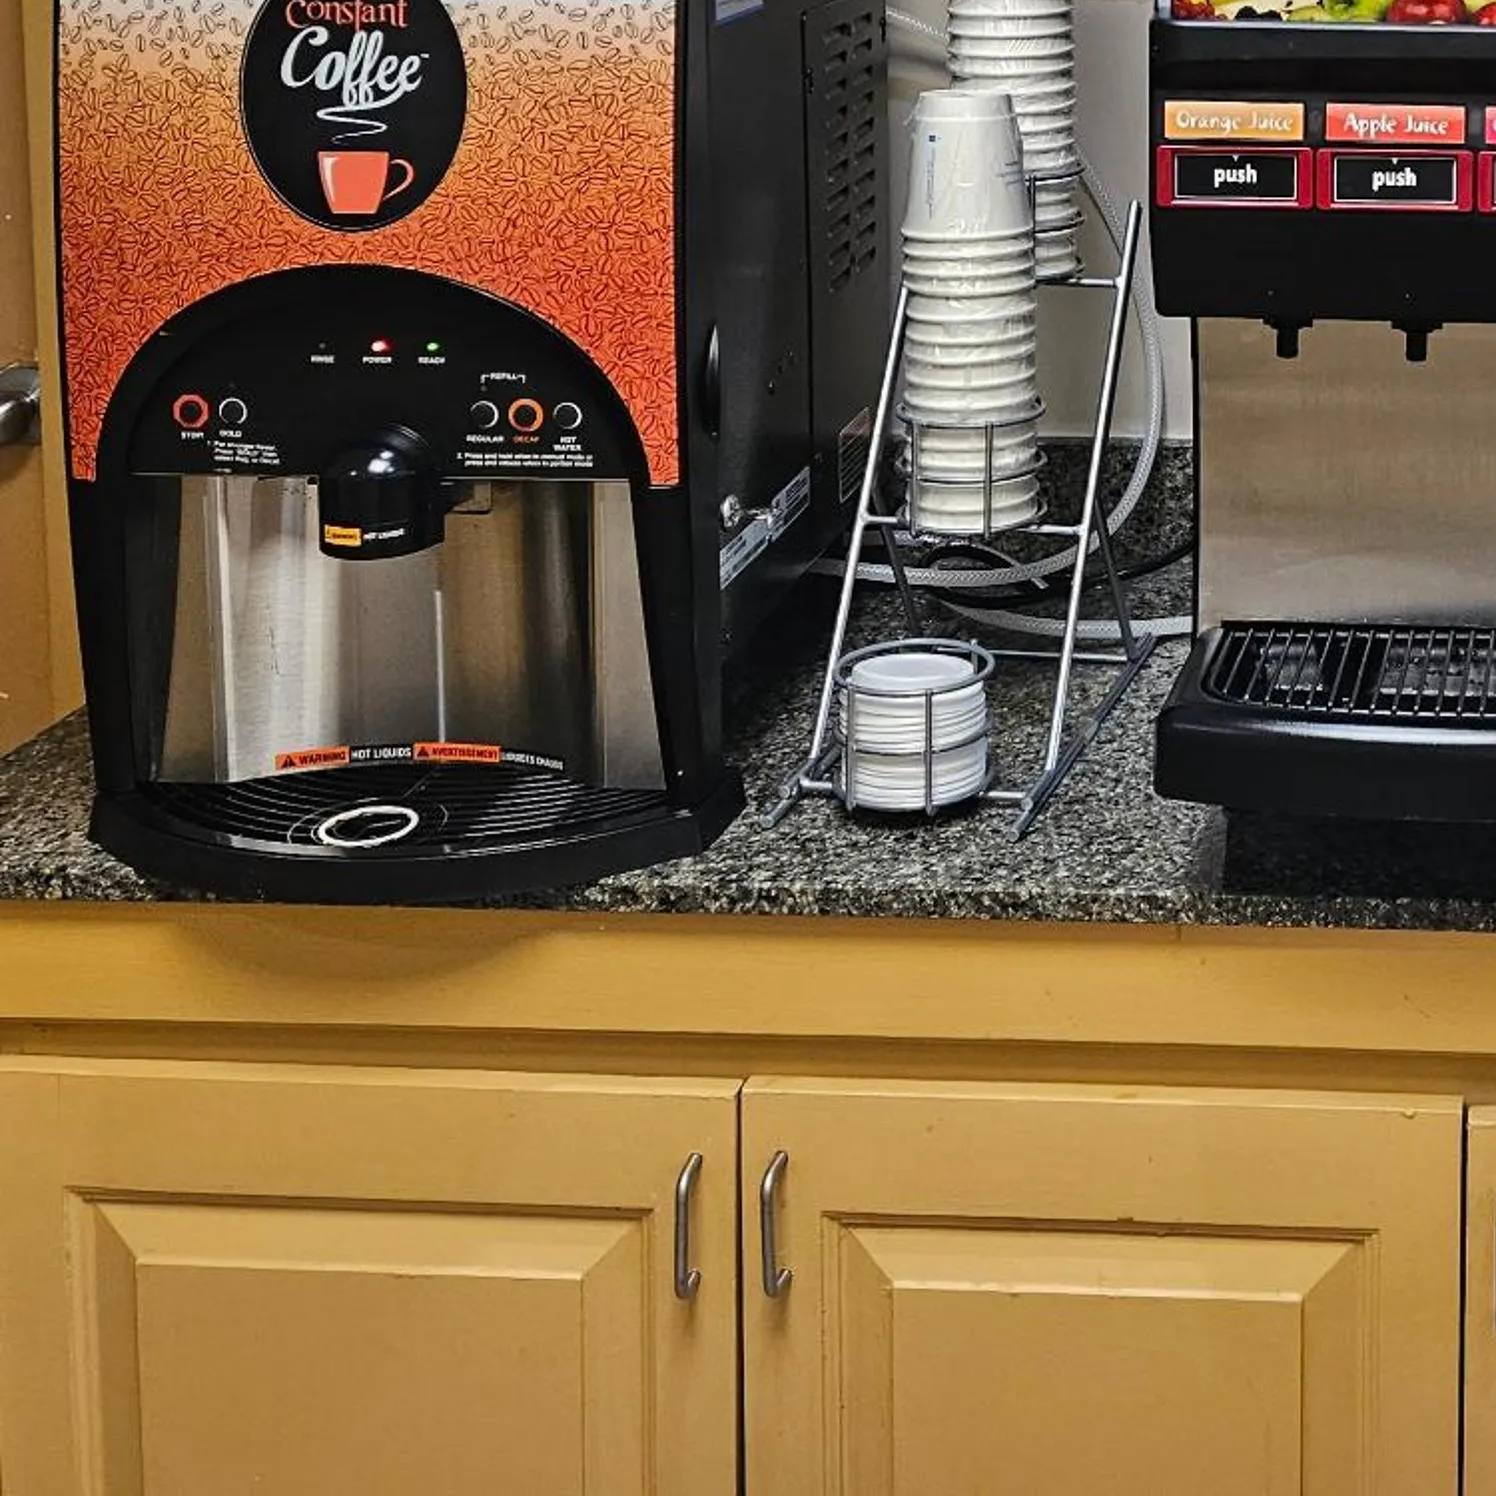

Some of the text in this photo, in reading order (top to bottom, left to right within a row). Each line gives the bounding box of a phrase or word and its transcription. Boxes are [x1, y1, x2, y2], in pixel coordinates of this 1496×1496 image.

[281, 25, 423, 108] Coffee
[1176, 112, 1294, 134] Orange Juice
[1345, 112, 1448, 137] Apple Juice
[1214, 163, 1258, 188] push
[1372, 167, 1417, 192] push
